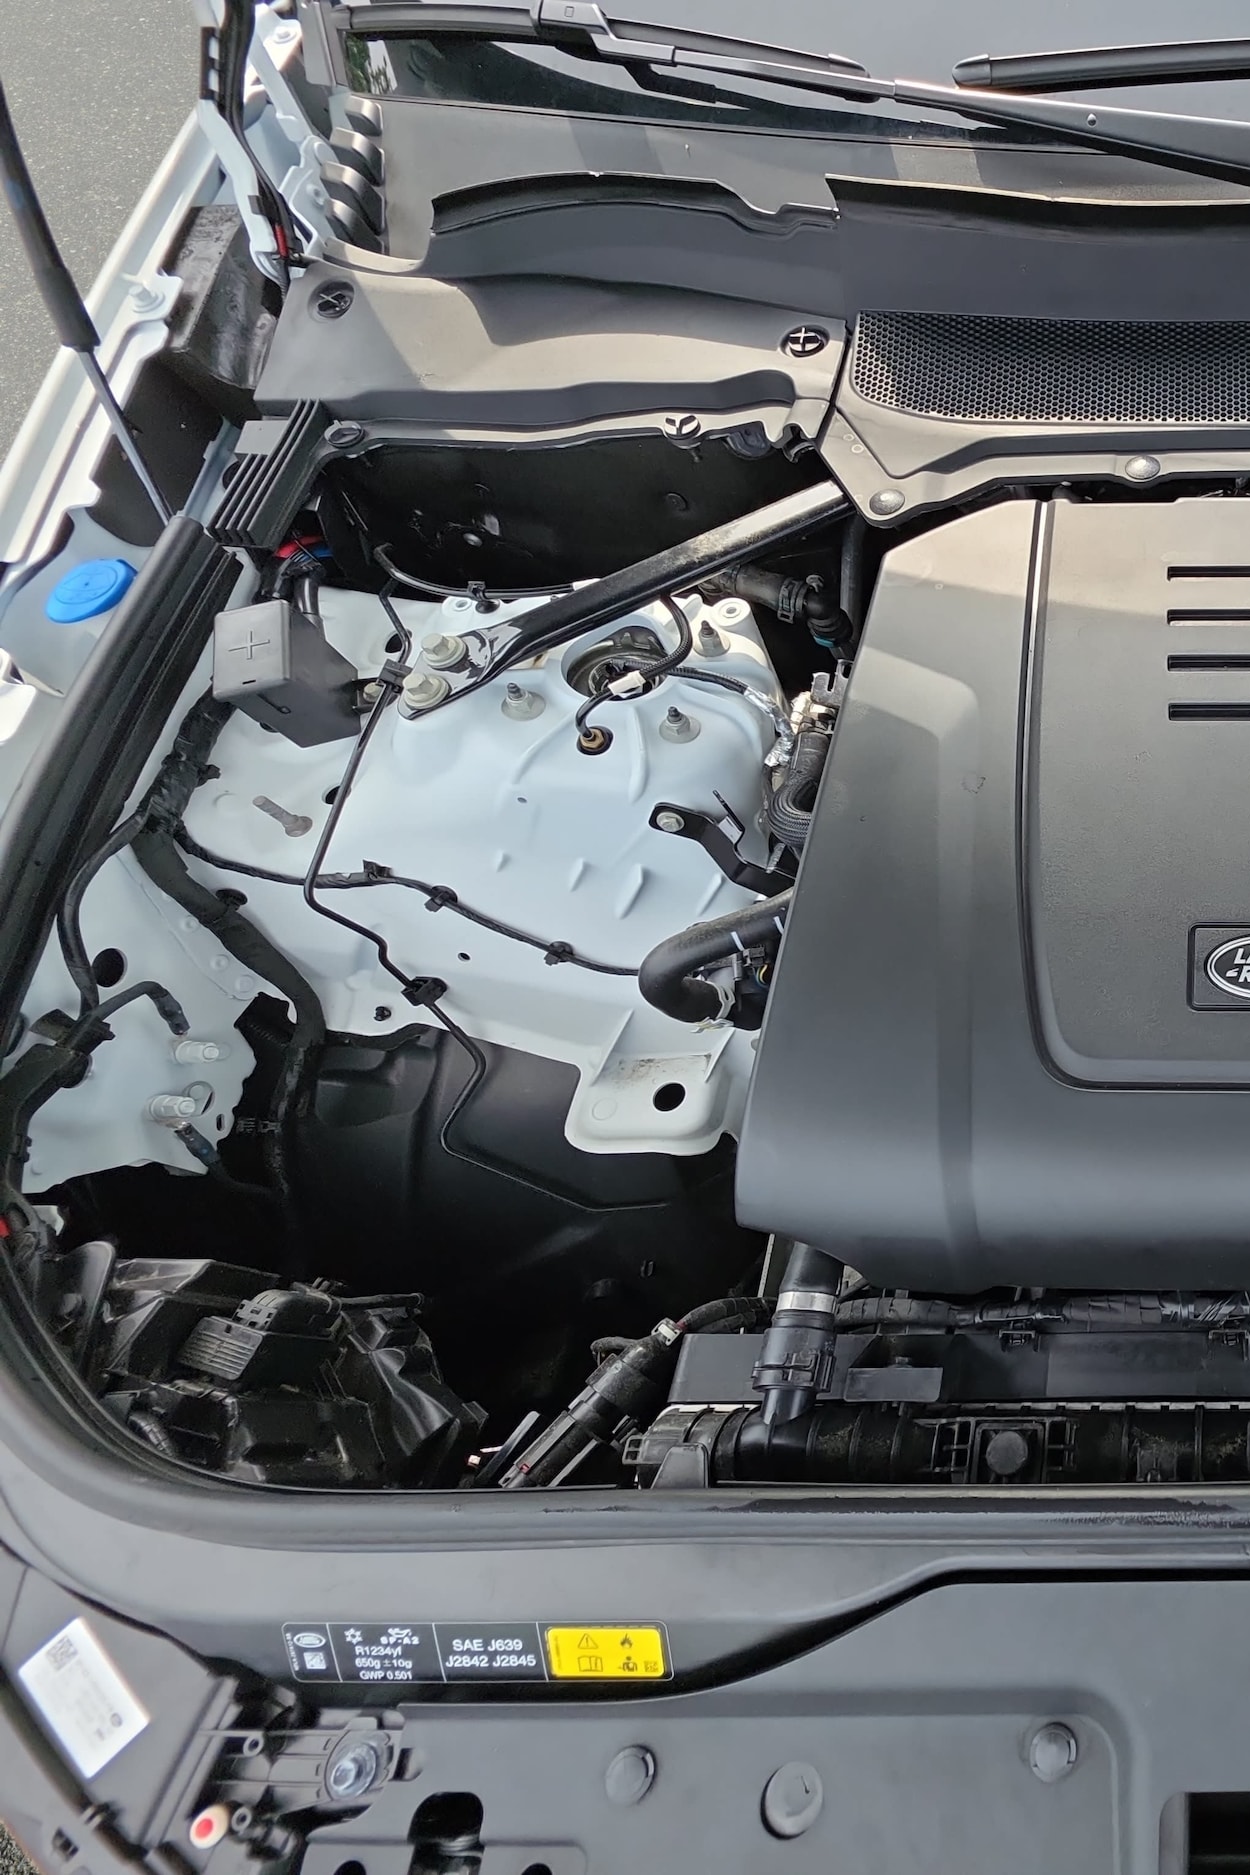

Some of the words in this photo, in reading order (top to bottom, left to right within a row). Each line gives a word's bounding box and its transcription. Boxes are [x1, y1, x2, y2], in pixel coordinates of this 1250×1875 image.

[354, 1645, 402, 1658] R1234yf
[452, 1638, 485, 1652] SAE
[487, 1638, 523, 1652] J639
[354, 1657, 381, 1670] 650g
[445, 1655, 490, 1668] J2842
[492, 1654, 537, 1667] J2845
[359, 1670, 385, 1680] GWP
[386, 1670, 413, 1680] 0.501
